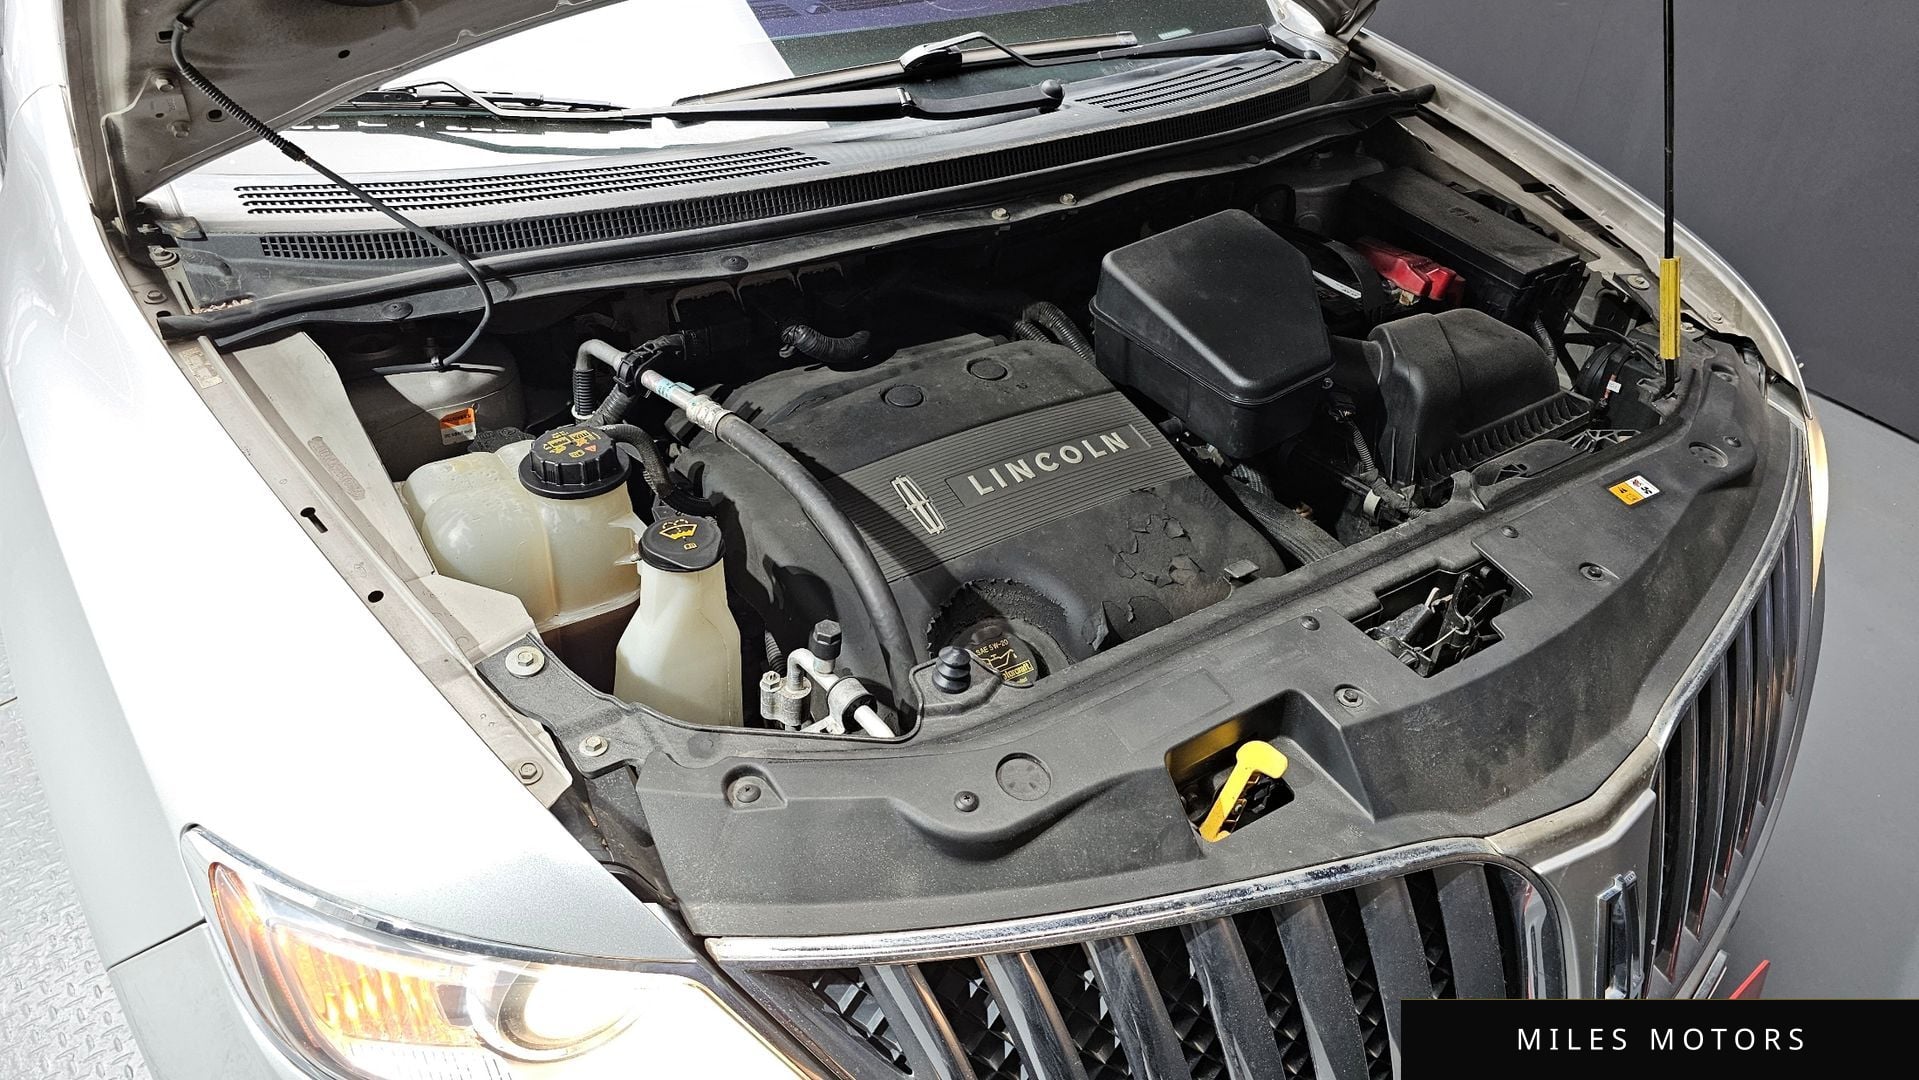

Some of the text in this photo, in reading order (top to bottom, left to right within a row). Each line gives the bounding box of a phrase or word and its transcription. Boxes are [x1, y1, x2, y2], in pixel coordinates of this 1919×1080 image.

[967, 432, 1130, 496] LINCOLN
[975, 645, 989, 656] SAE
[1002, 662, 1031, 680] otorcraft
